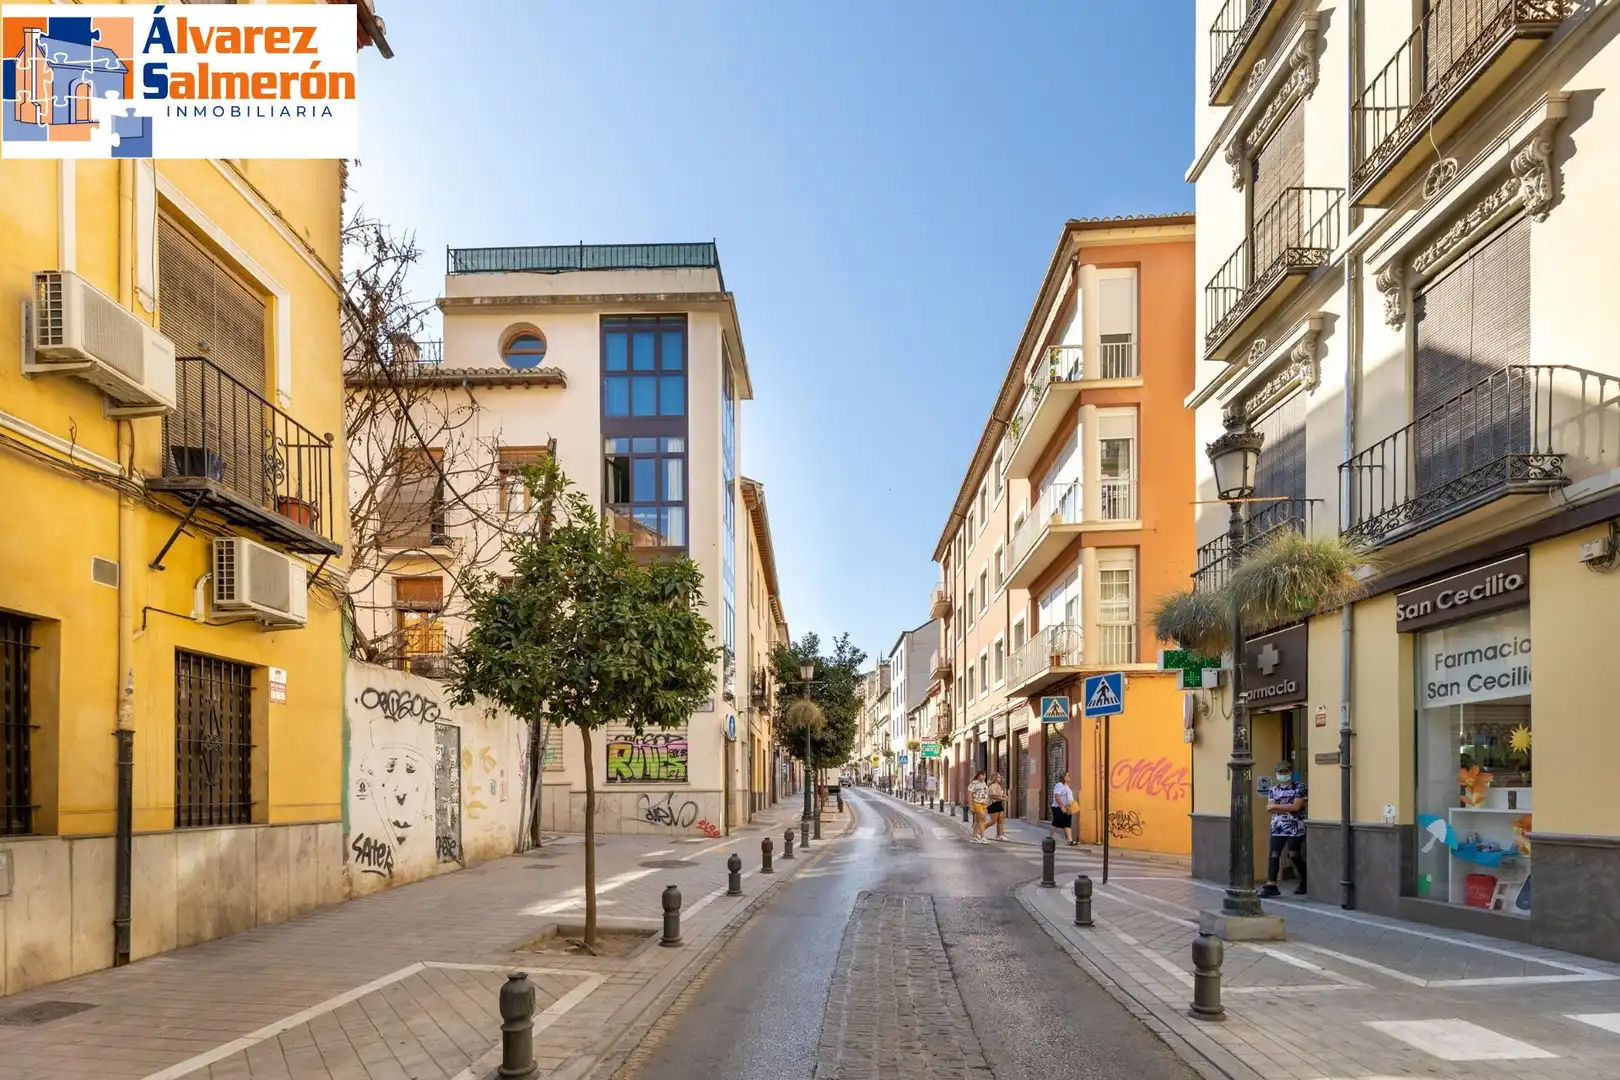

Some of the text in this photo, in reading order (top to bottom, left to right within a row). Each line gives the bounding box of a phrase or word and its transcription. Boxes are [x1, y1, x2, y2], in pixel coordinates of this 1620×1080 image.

[1396, 572, 1522, 622] San Cecilio
[1246, 679, 1296, 701] armacia
[1427, 665, 1532, 700] San Cecili
